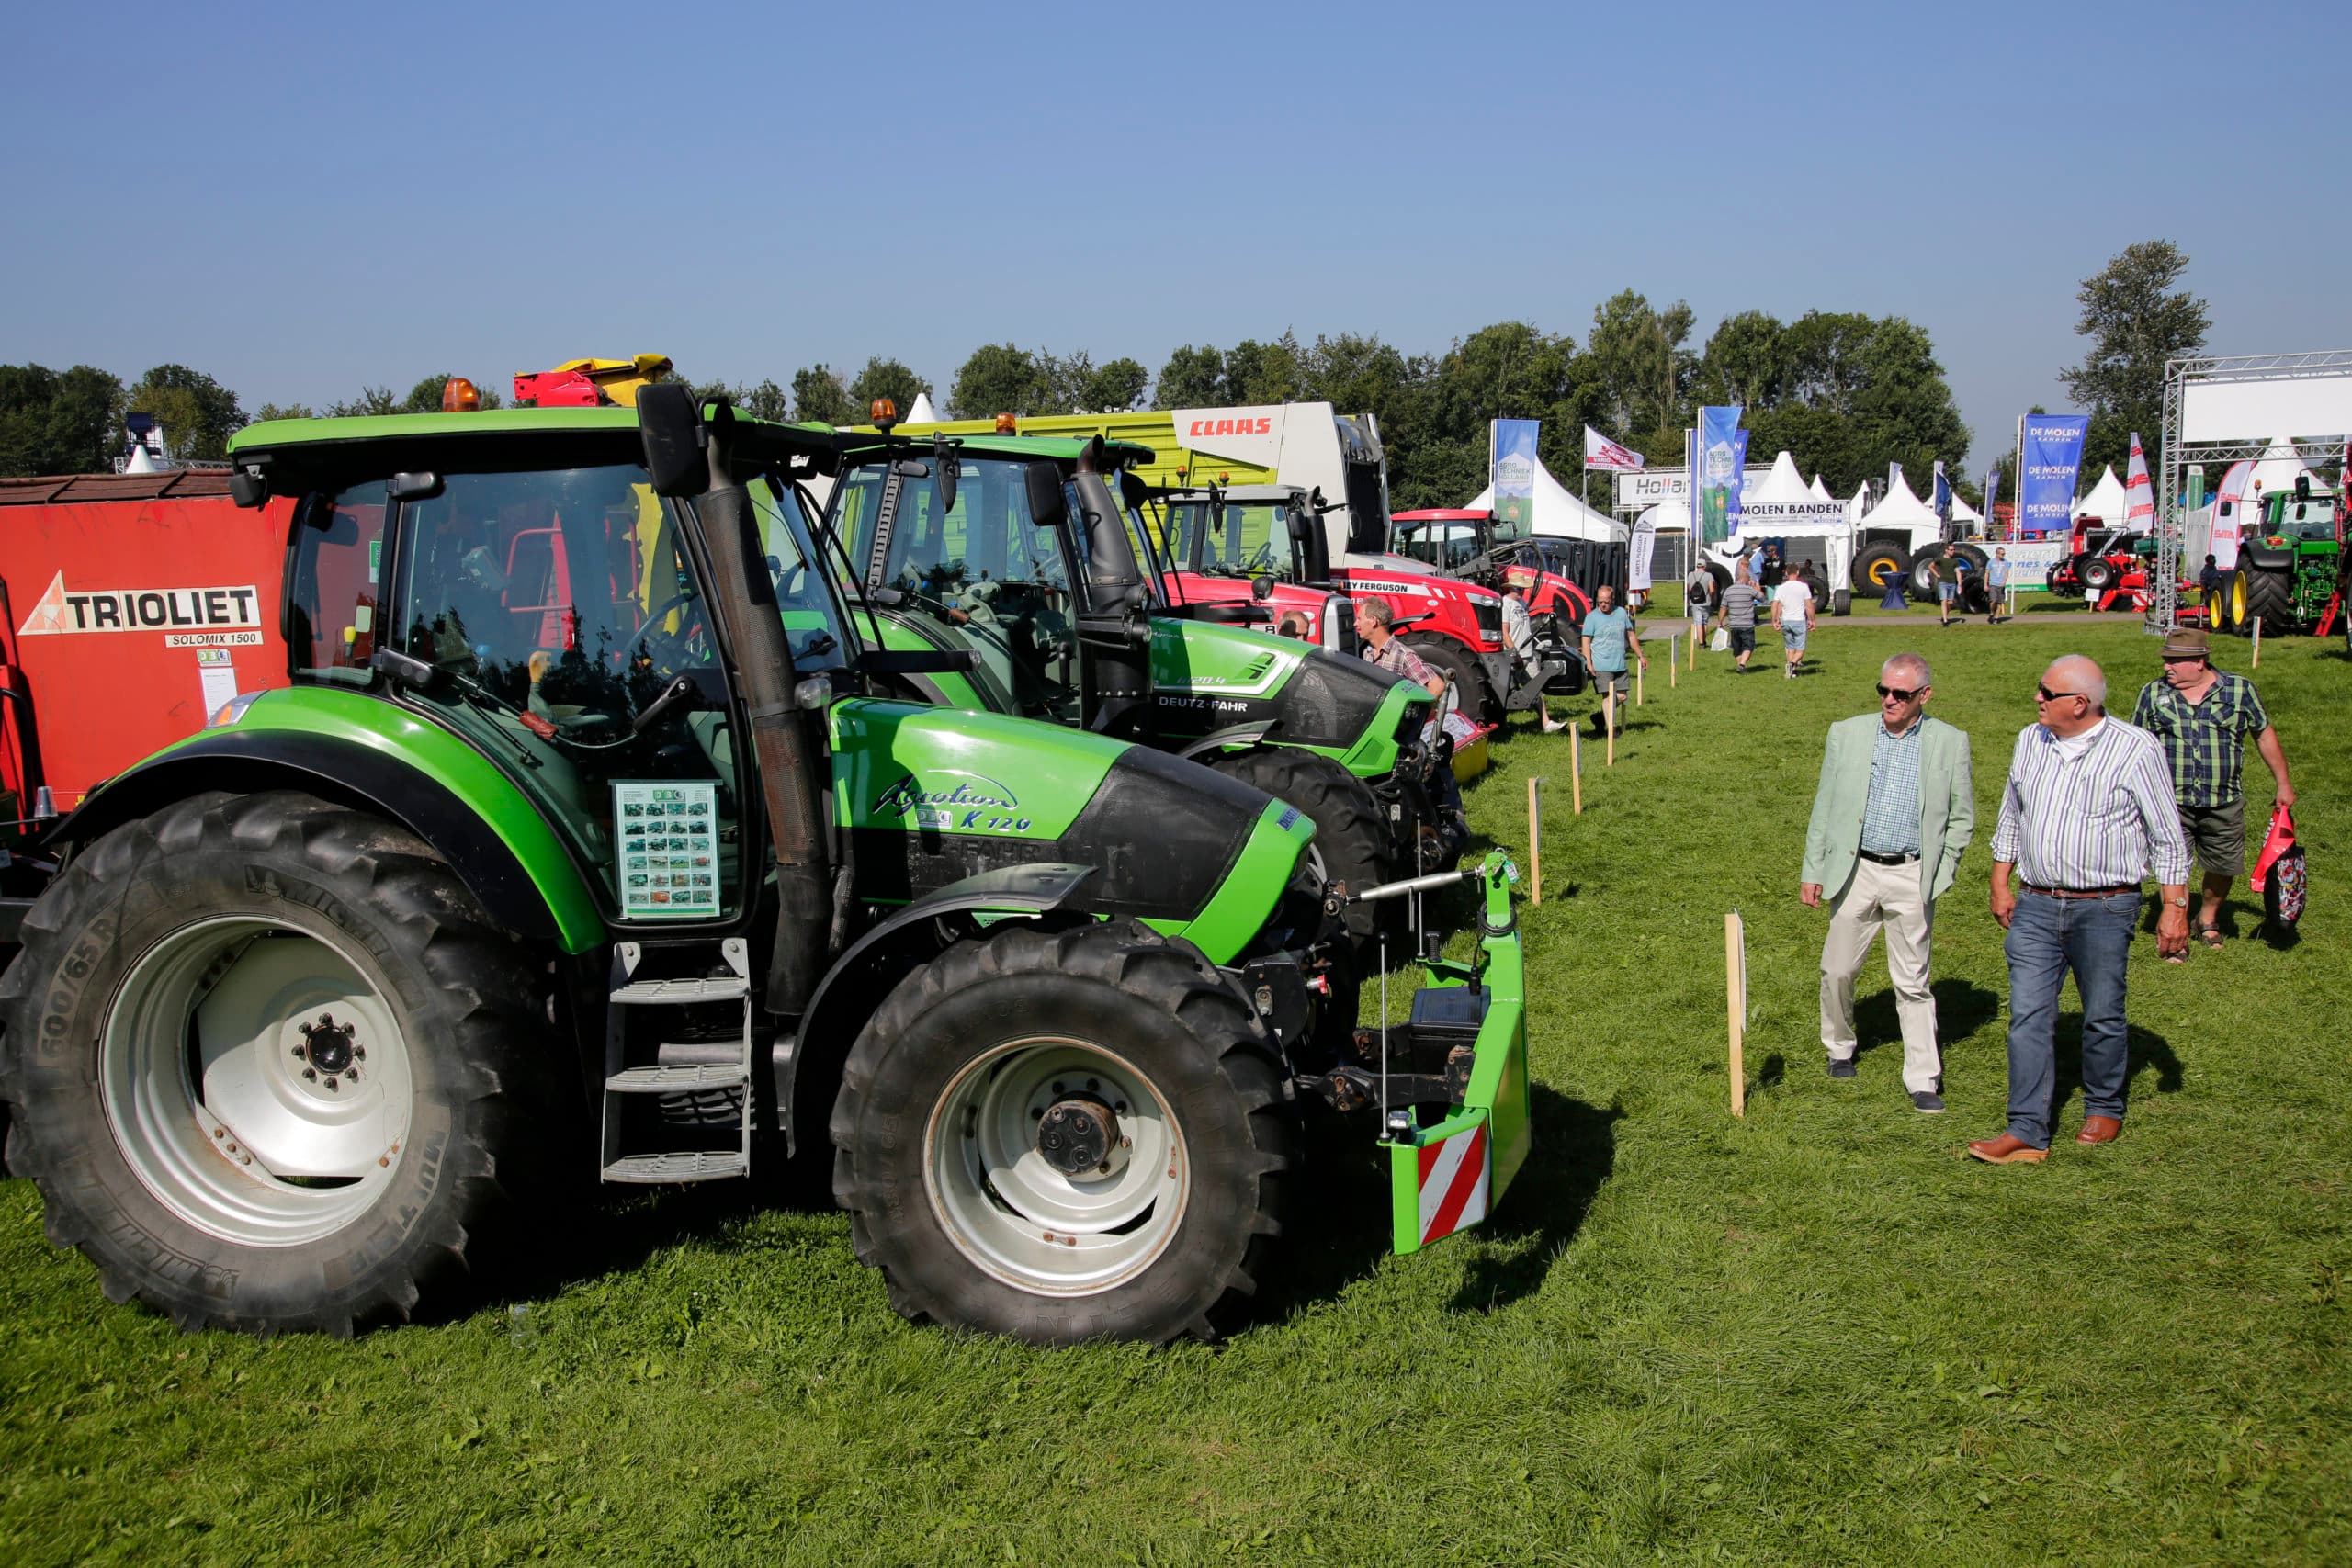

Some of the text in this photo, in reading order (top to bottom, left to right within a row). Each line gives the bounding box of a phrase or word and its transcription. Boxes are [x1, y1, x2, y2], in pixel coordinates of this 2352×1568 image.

[1190, 418, 1272, 436] CLAAS
[2044, 429, 2080, 437] MOLEN
[1789, 504, 1842, 514] BANDEN
[1360, 582, 1408, 592] FERGUSON
[66, 589, 253, 629] TRIOLIET
[173, 633, 256, 646] SOLOMIX 1500
[960, 810, 1032, 832] K 120
[41, 941, 99, 1058] 600/65
